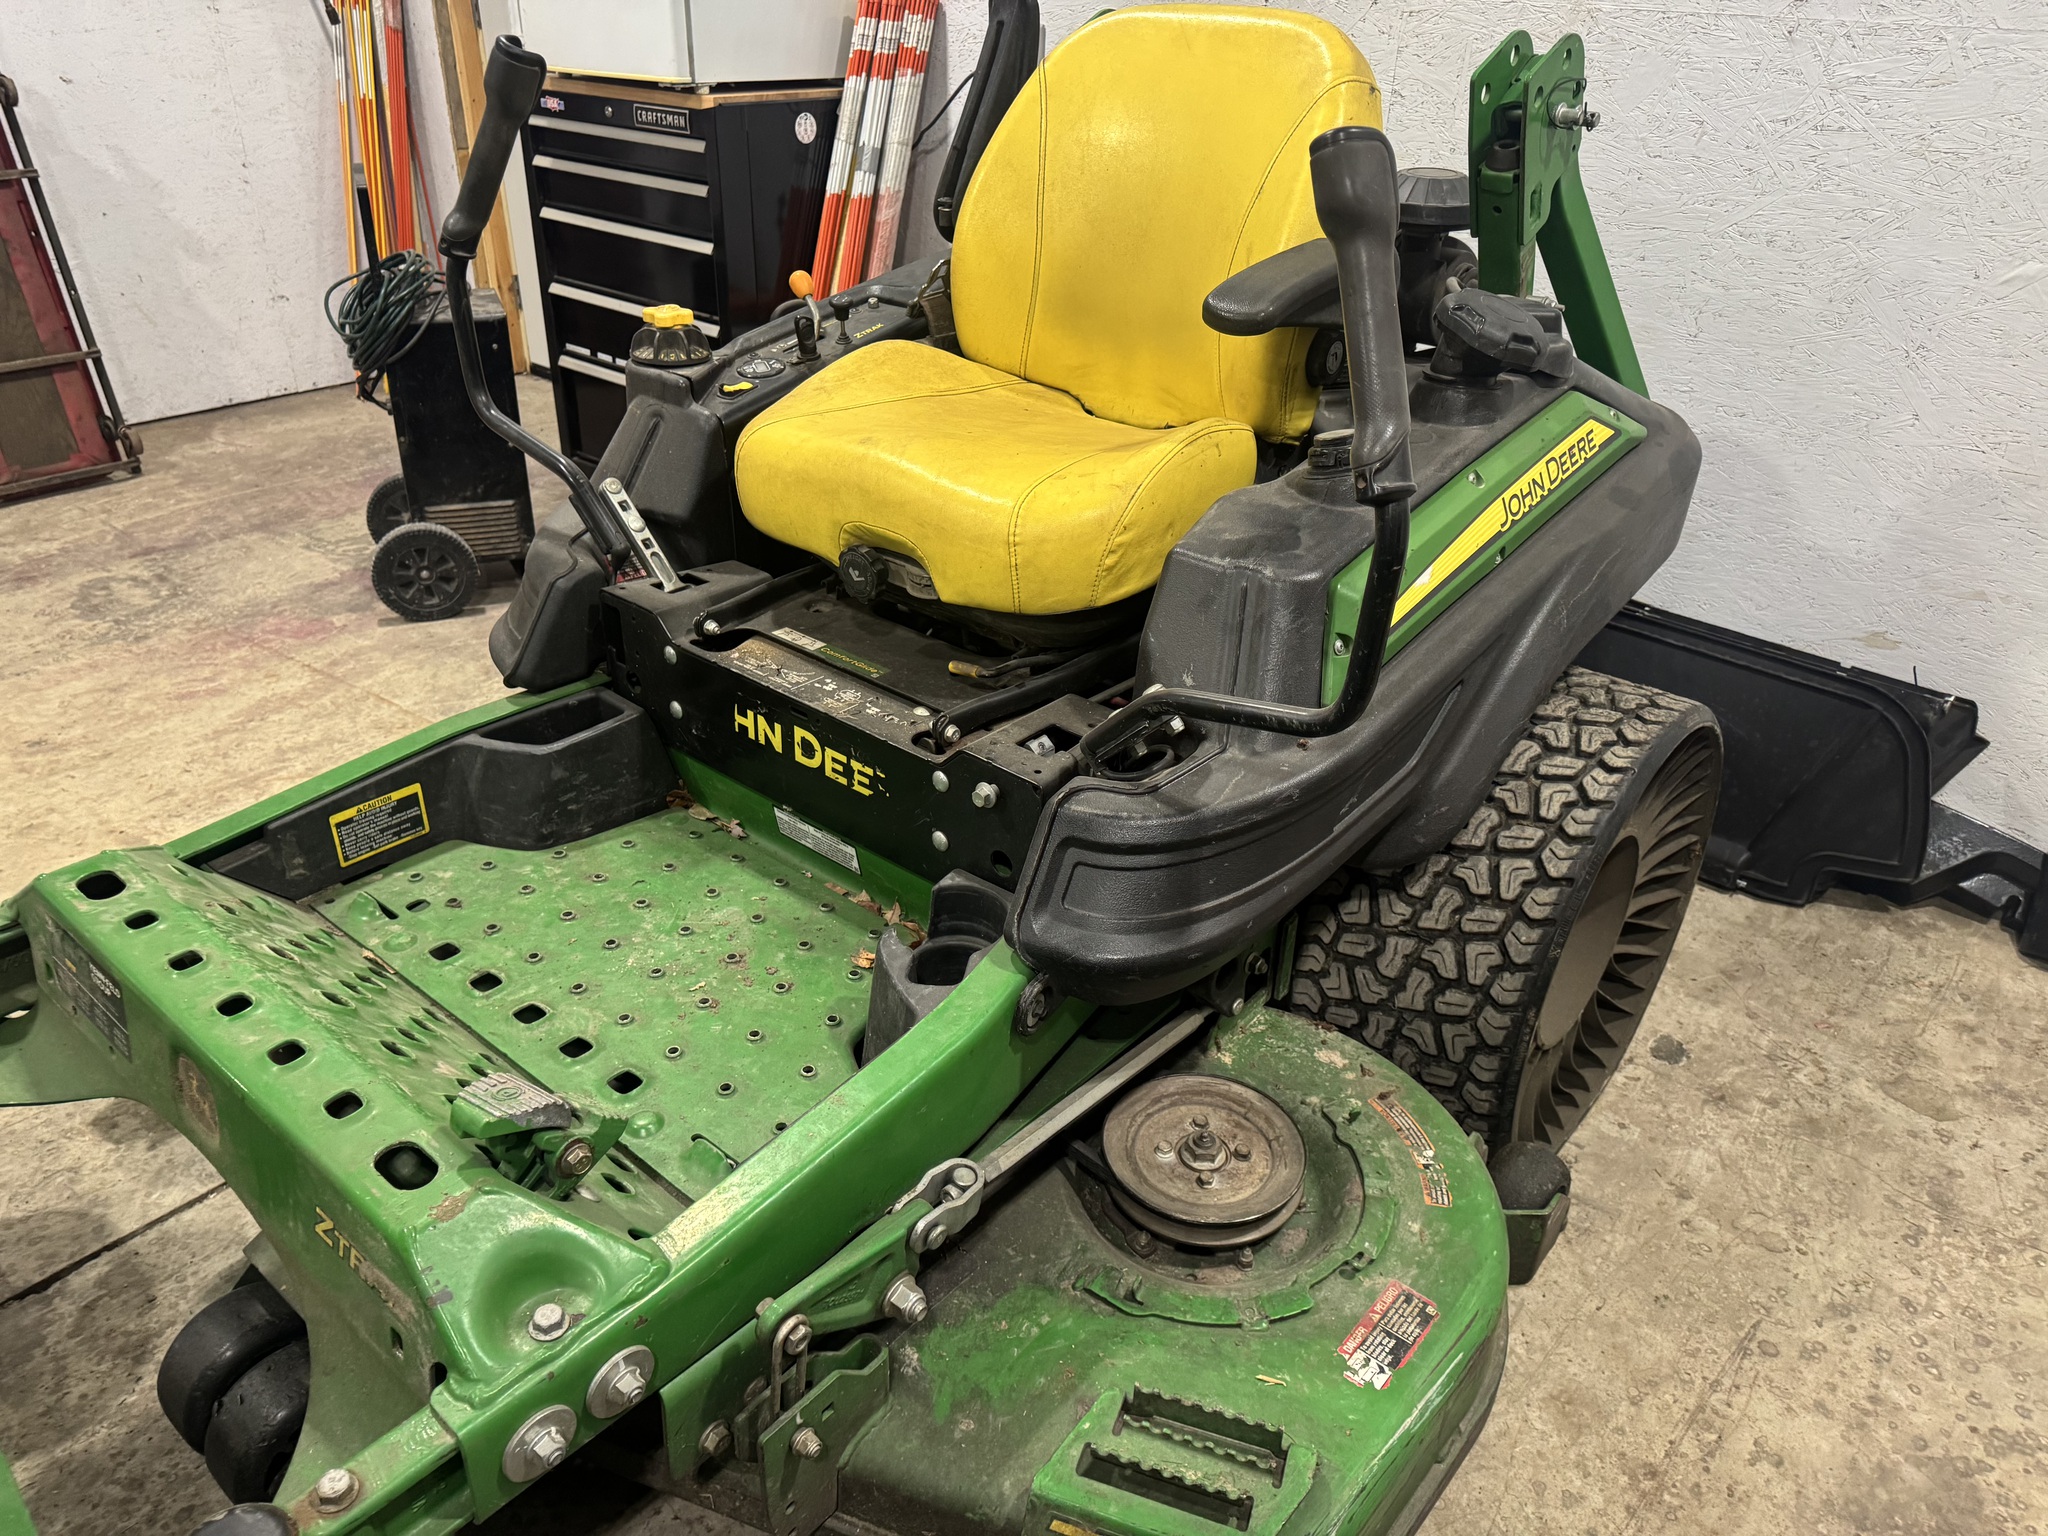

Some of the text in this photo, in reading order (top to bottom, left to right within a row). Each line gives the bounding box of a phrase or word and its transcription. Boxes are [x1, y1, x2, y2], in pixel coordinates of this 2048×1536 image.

[637, 109, 686, 128] CRAFTSMAN
[853, 323, 884, 339] ZTRAK
[1500, 428, 1597, 529] JOHN DEERE
[794, 725, 889, 797] DEE
[362, 795, 392, 810] CAUTION
[353, 813, 365, 821] HELP
[1374, 1286, 1399, 1314] PELIGRO
[1343, 1327, 1368, 1353] DANGER
